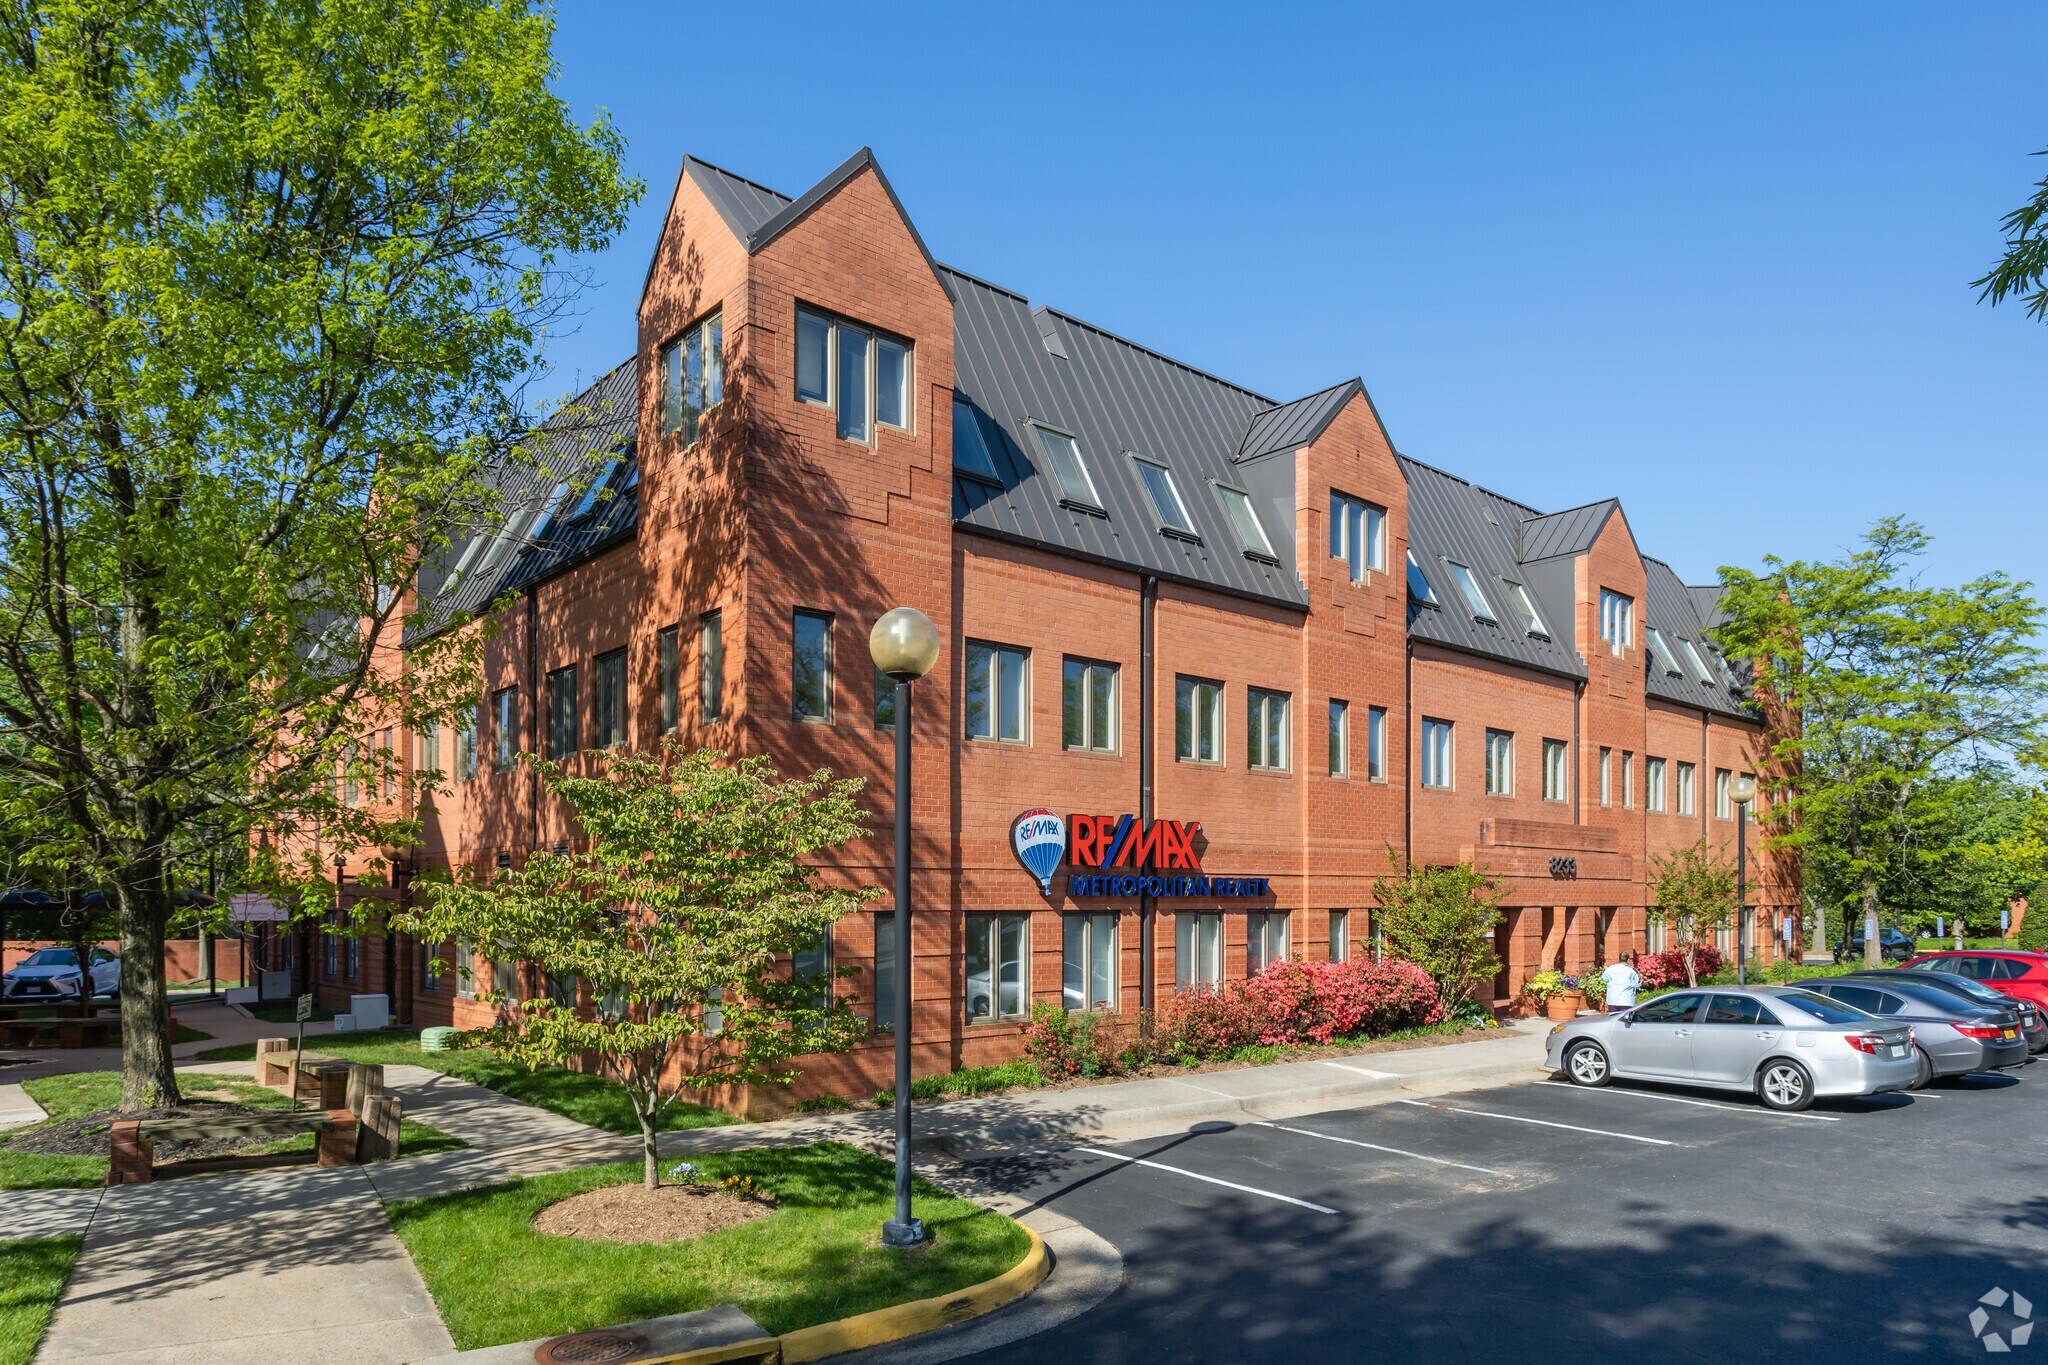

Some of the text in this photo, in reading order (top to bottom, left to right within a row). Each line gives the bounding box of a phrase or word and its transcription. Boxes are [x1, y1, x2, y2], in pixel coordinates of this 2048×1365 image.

[1020, 820, 1059, 842] RE/MAX
[1071, 813, 1200, 869] RE/MAX
[1550, 857, 1576, 873] 8233
[1072, 874, 1270, 897] METROPOLITAN REALTY
